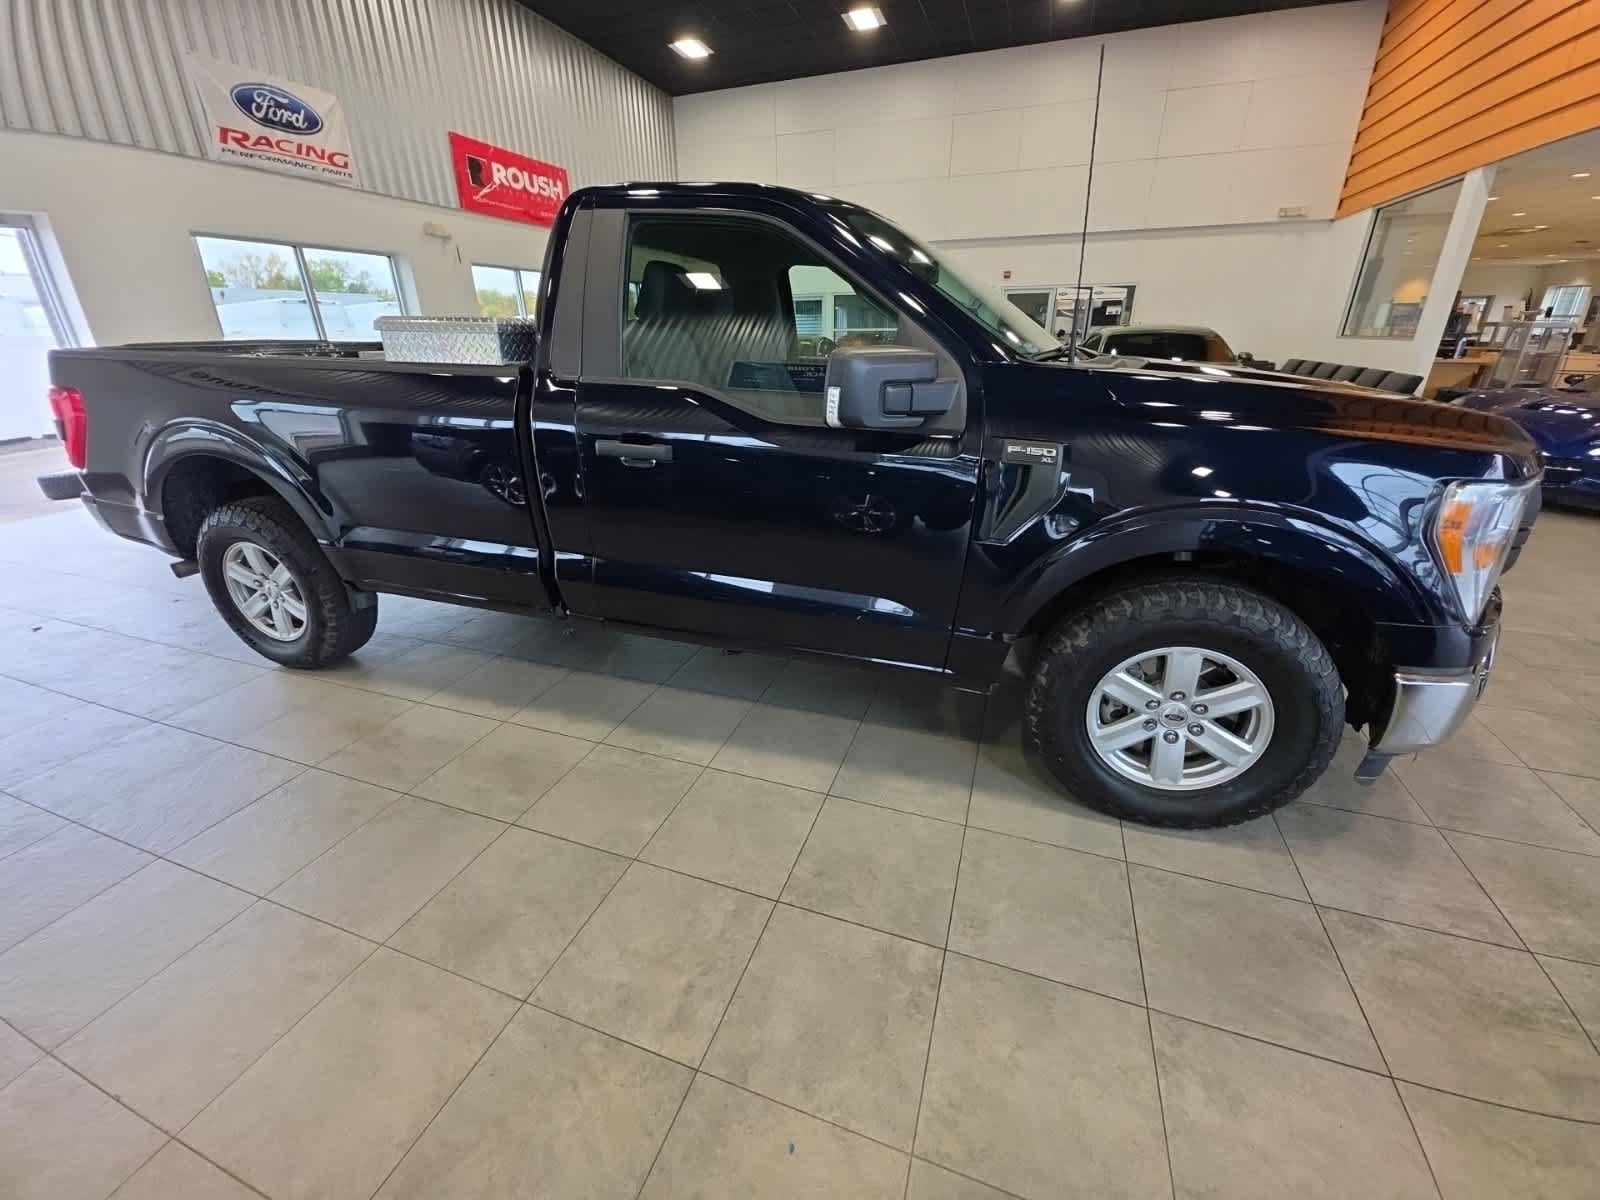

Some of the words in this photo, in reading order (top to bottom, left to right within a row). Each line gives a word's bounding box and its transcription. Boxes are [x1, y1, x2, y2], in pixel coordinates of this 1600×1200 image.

[252, 90, 307, 128] Ford
[218, 127, 349, 169] RACING
[221, 147, 320, 170] PERFORMANCE
[321, 168, 353, 178] PARTS
[491, 161, 563, 200] ROUSH
[1007, 445, 1056, 456] F-150
